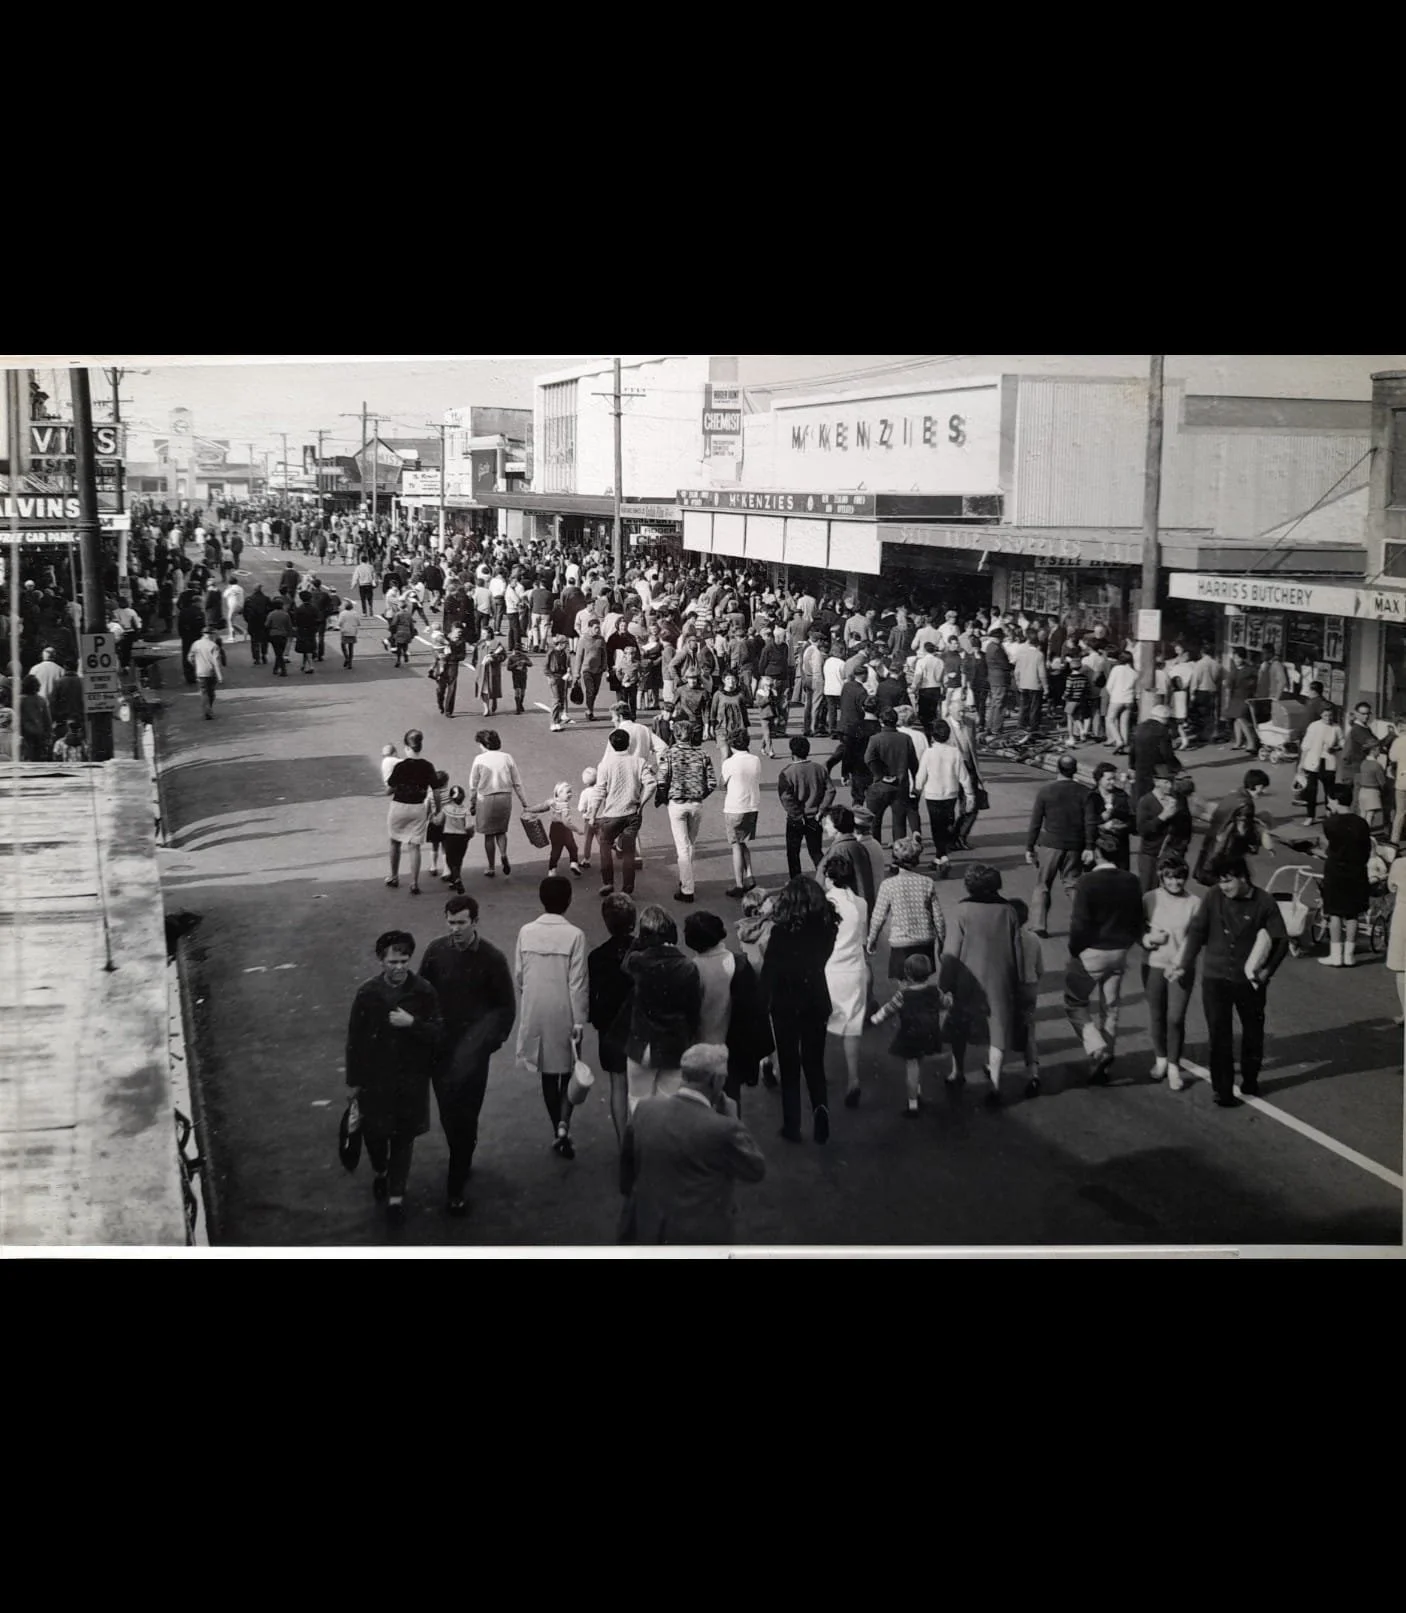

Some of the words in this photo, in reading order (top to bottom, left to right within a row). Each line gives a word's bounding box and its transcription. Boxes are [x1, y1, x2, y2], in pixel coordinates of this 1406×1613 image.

[704, 412, 740, 431] CHEMIST
[32, 427, 116, 454] VIS
[0, 498, 80, 518] LVINS
[729, 492, 794, 510] McKENZIES
[25, 532, 46, 542] CAR
[48, 532, 76, 542] PARK
[1199, 575, 1248, 600] HARRIS'S
[1251, 583, 1313, 606] BUTCHERY
[1375, 597, 1400, 614] MAX
[94, 636, 105, 653] P
[87, 654, 111, 668] 60
